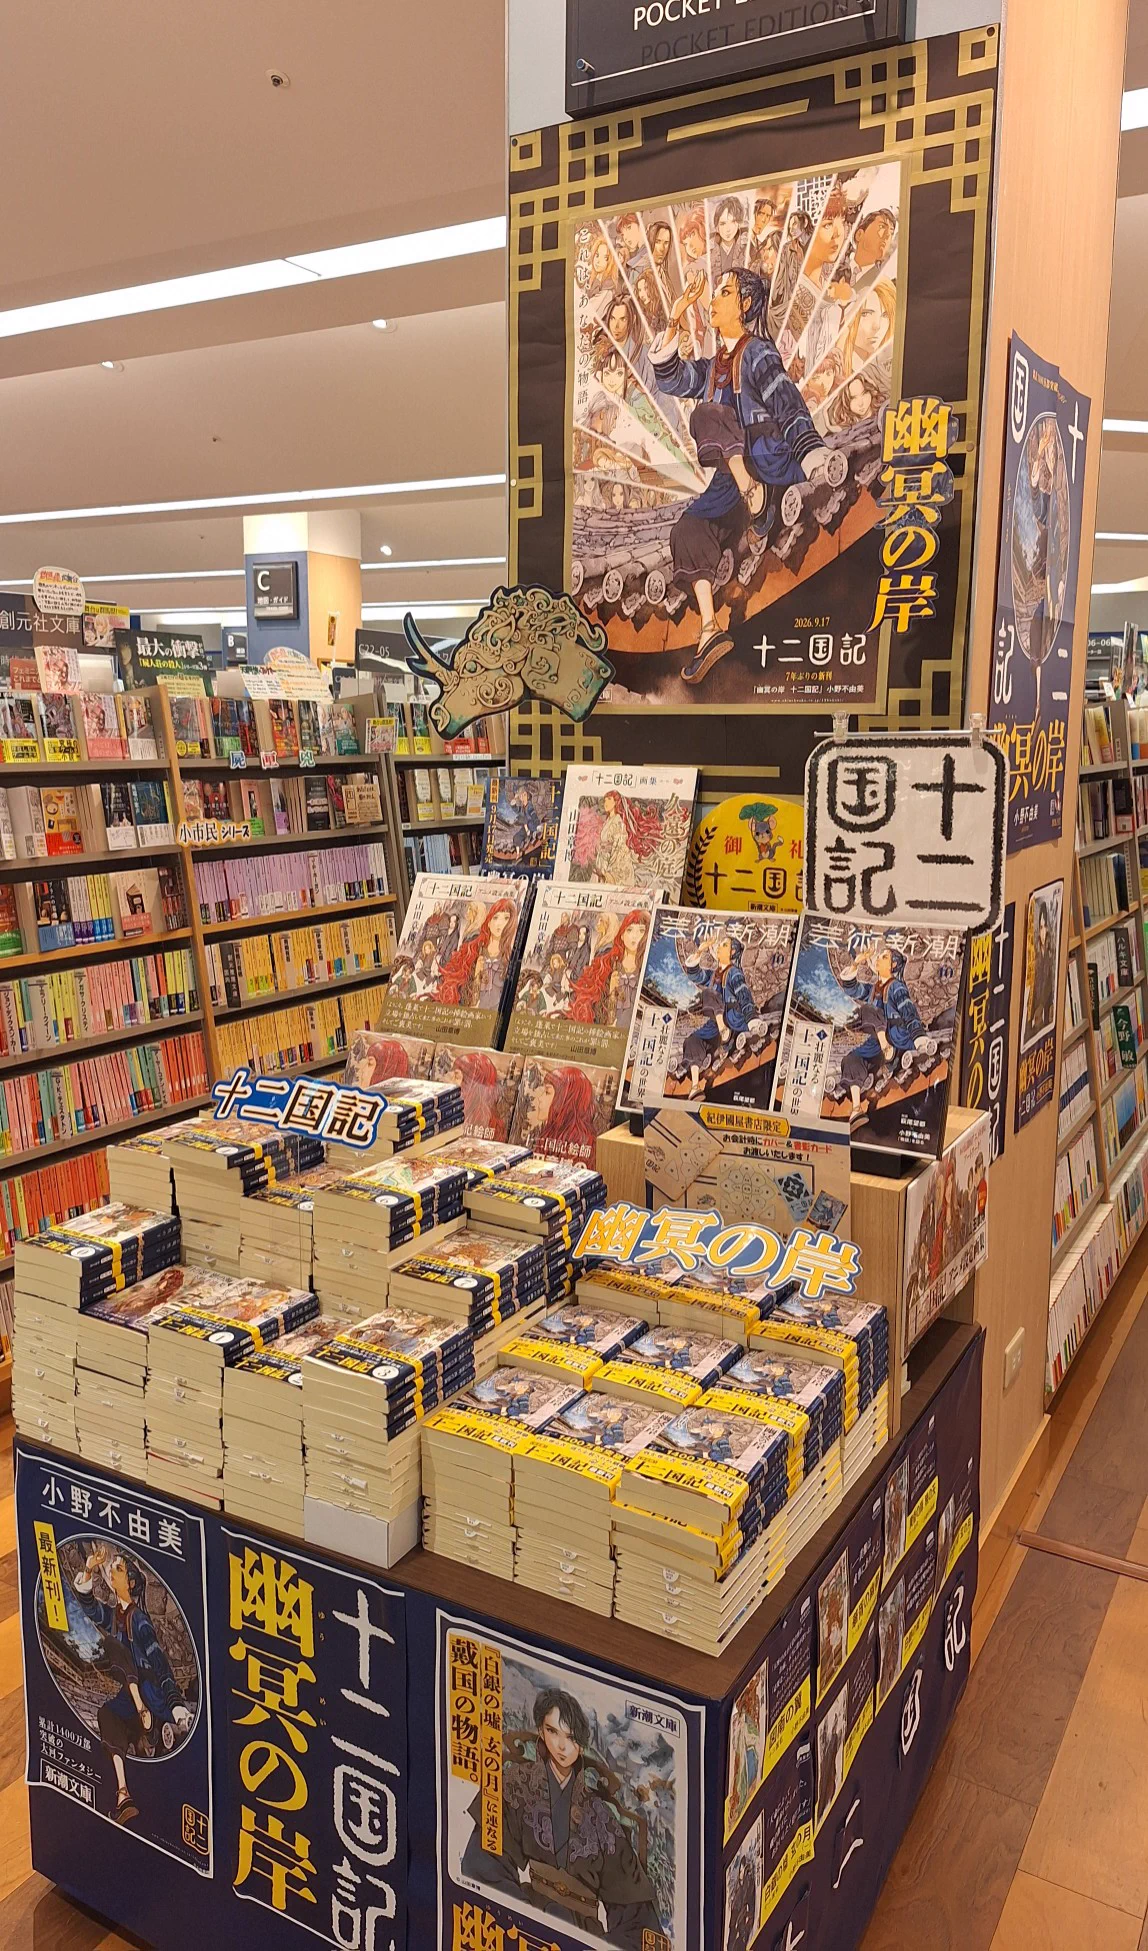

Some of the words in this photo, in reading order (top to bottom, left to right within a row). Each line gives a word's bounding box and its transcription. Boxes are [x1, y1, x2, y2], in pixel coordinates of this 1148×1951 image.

[867, 400, 953, 635] 幽冥の岸
[257, 571, 270, 591] C
[0, 611, 81, 634] 創元社文庫
[794, 617, 830, 628] 2026.9.17
[136, 637, 200, 659] 最大の衝撃
[228, 635, 234, 647] B
[752, 632, 867, 668] 十二国記
[785, 671, 833, 681] 7年ぶりの新刊
[180, 823, 249, 843] 小市民シリーズ
[656, 792, 683, 878] 久遠の庭
[725, 836, 742, 855] 御
[790, 840, 803, 859] 礼
[430, 883, 473, 898] 十二国記
[553, 890, 602, 908] 十二国記
[750, 903, 776, 913] 新潮文庫
[660, 915, 791, 948] 芸術新潮
[807, 923, 957, 962] 芸術新潮
[656, 1024, 671, 1065] 壮麗なる
[811, 1041, 826, 1085] 壮麗なる
[214, 1072, 382, 1145] 十二国記
[706, 1112, 782, 1134] 紀伊國屋書店限定
[579, 1208, 858, 1296] 幽冥の岸
[635, 1460, 704, 1489] 十二国記
[41, 1477, 185, 1556] 小野不由美
[37, 1532, 64, 1624] 最新刊！
[482, 1645, 501, 1732] 『白銀の墟
[228, 1546, 319, 1911] 幽冥の岸
[450, 1637, 481, 1785] 戴国の物語。
[628, 1703, 679, 1735] 新潮文庫
[38, 1715, 92, 1752] 累計1400万部
[39, 1729, 64, 1749] 突破の
[40, 1742, 102, 1780] 大河ファンタジー
[331, 1588, 401, 1951] 十二国記
[44, 1764, 93, 1804] 新潮文庫
